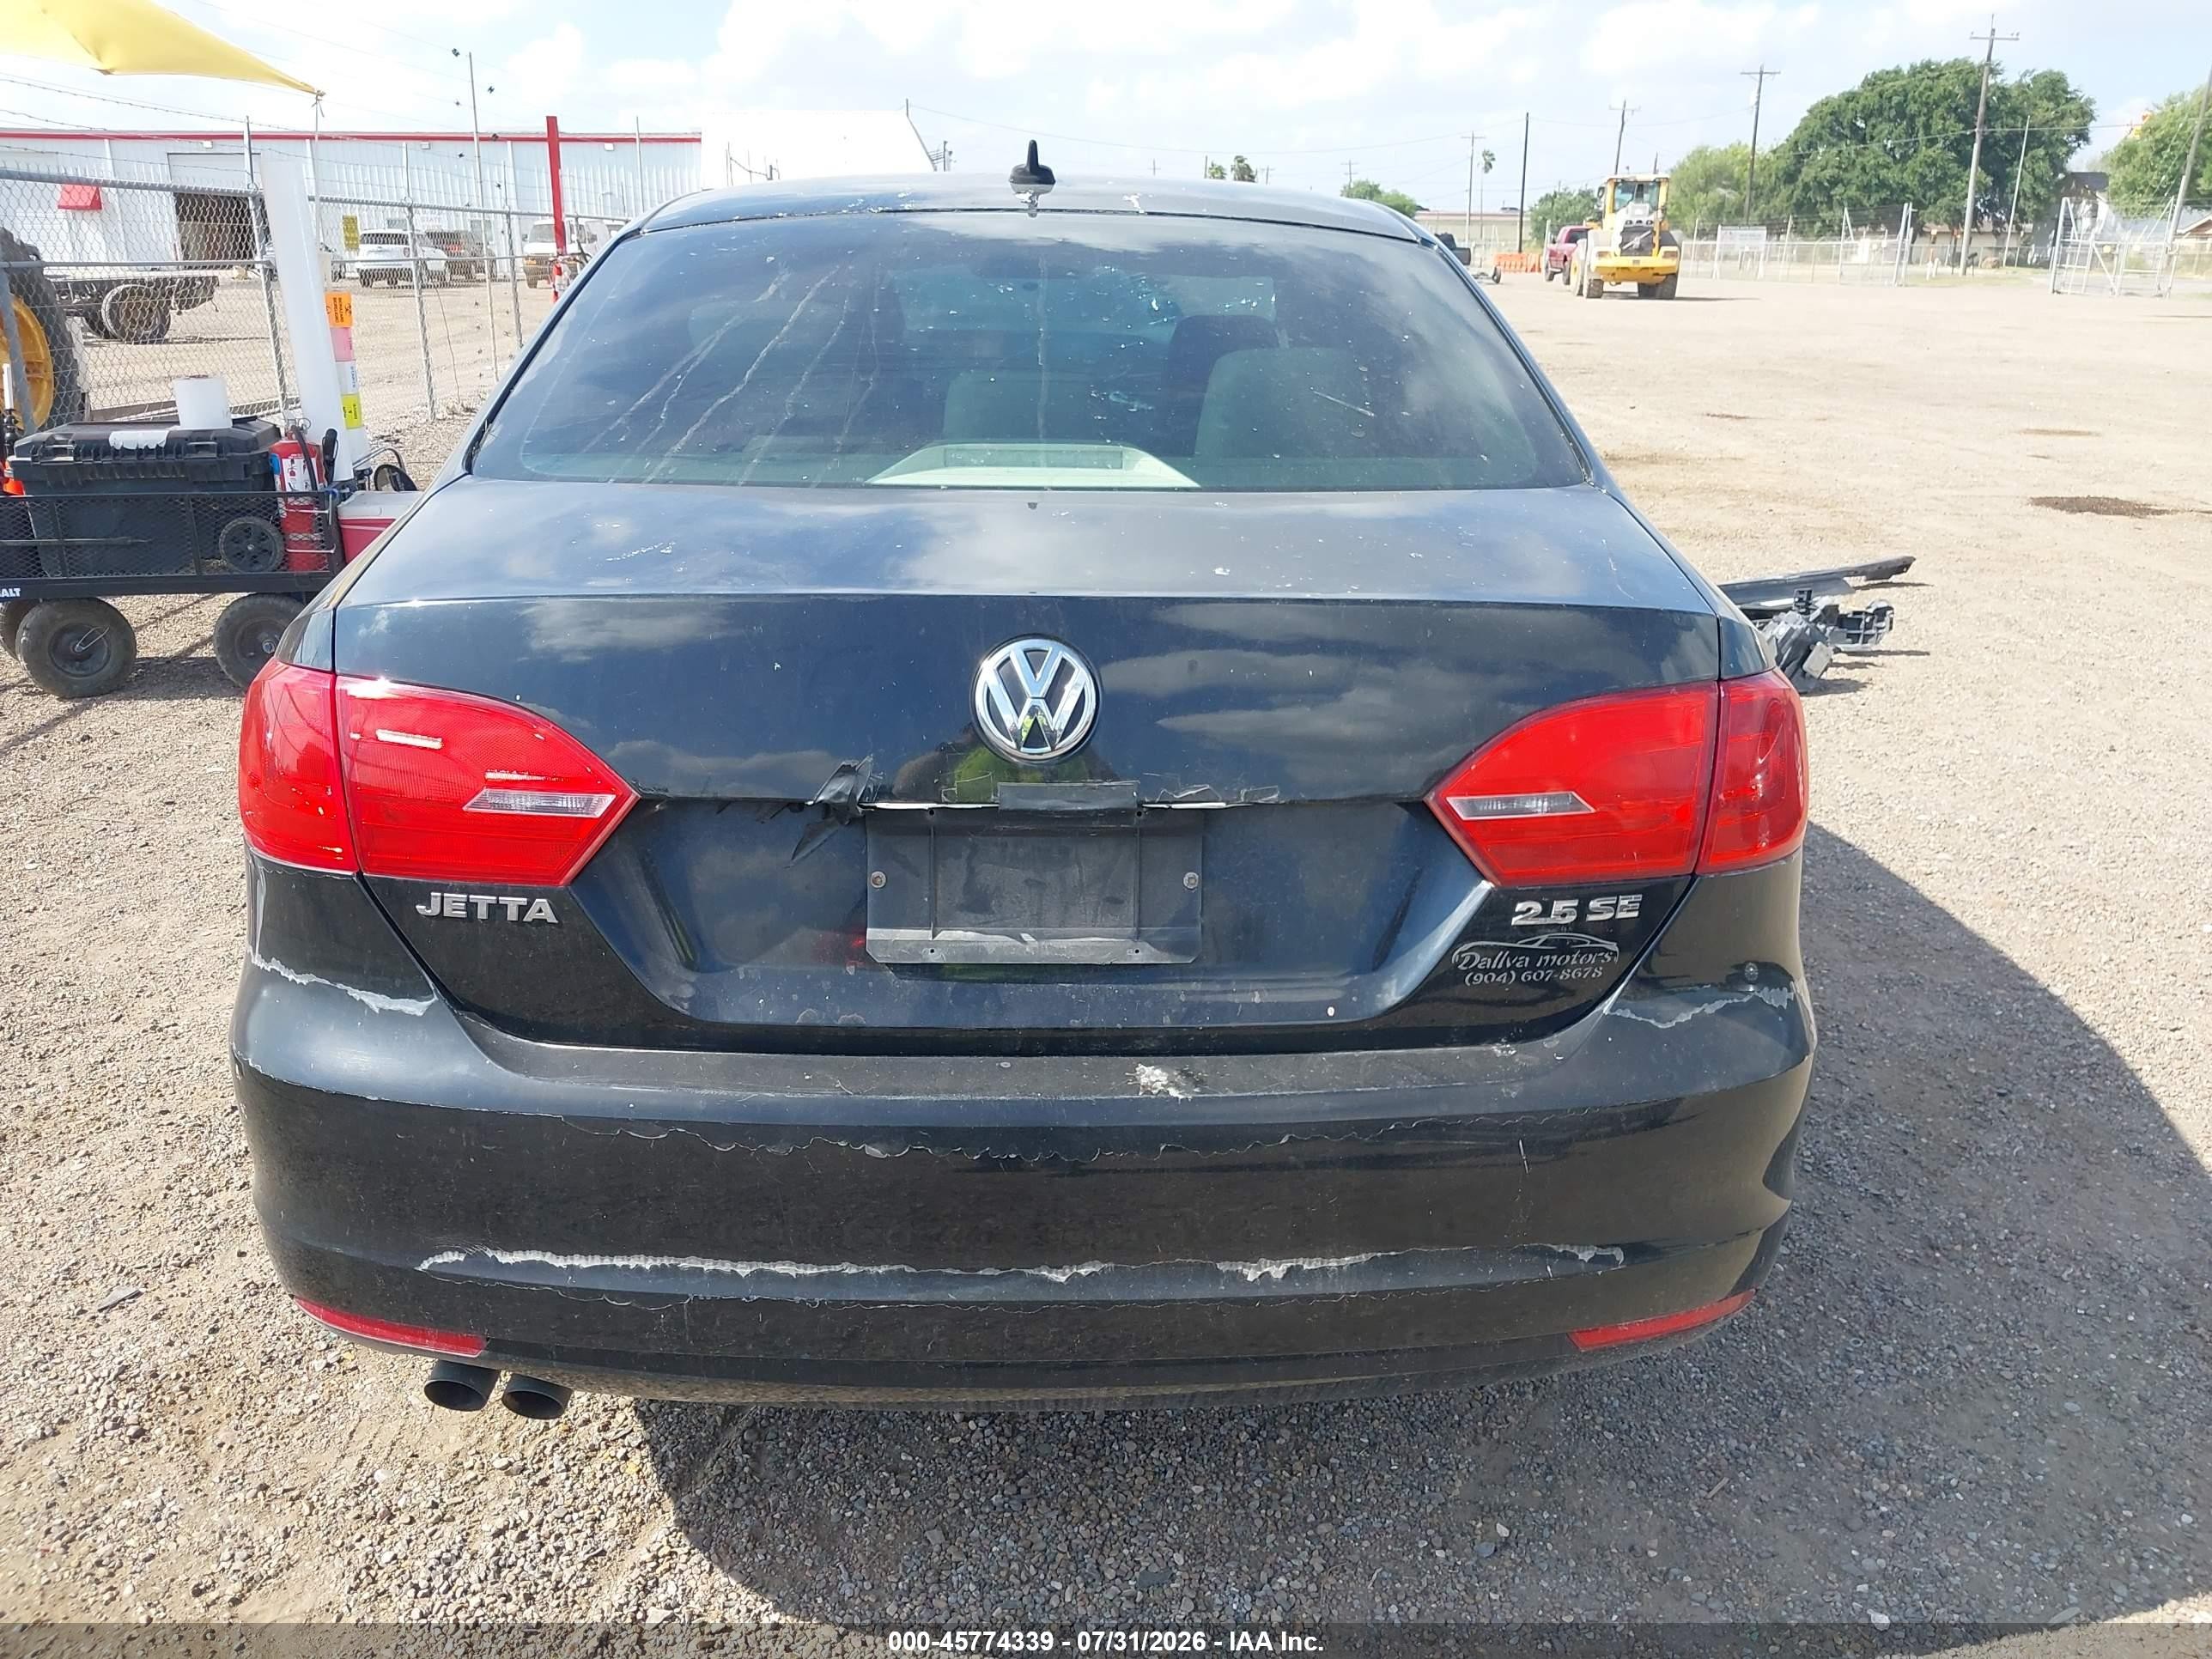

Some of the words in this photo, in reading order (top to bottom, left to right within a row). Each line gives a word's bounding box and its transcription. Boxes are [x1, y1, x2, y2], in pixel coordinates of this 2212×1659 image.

[0, 587, 21, 598] ALT
[416, 891, 559, 924] JETTA
[1586, 894, 1643, 921] SE
[1536, 949, 1613, 968] motors
[1464, 970, 1516, 986] (904)
[1521, 966, 1602, 981] 607-8678
